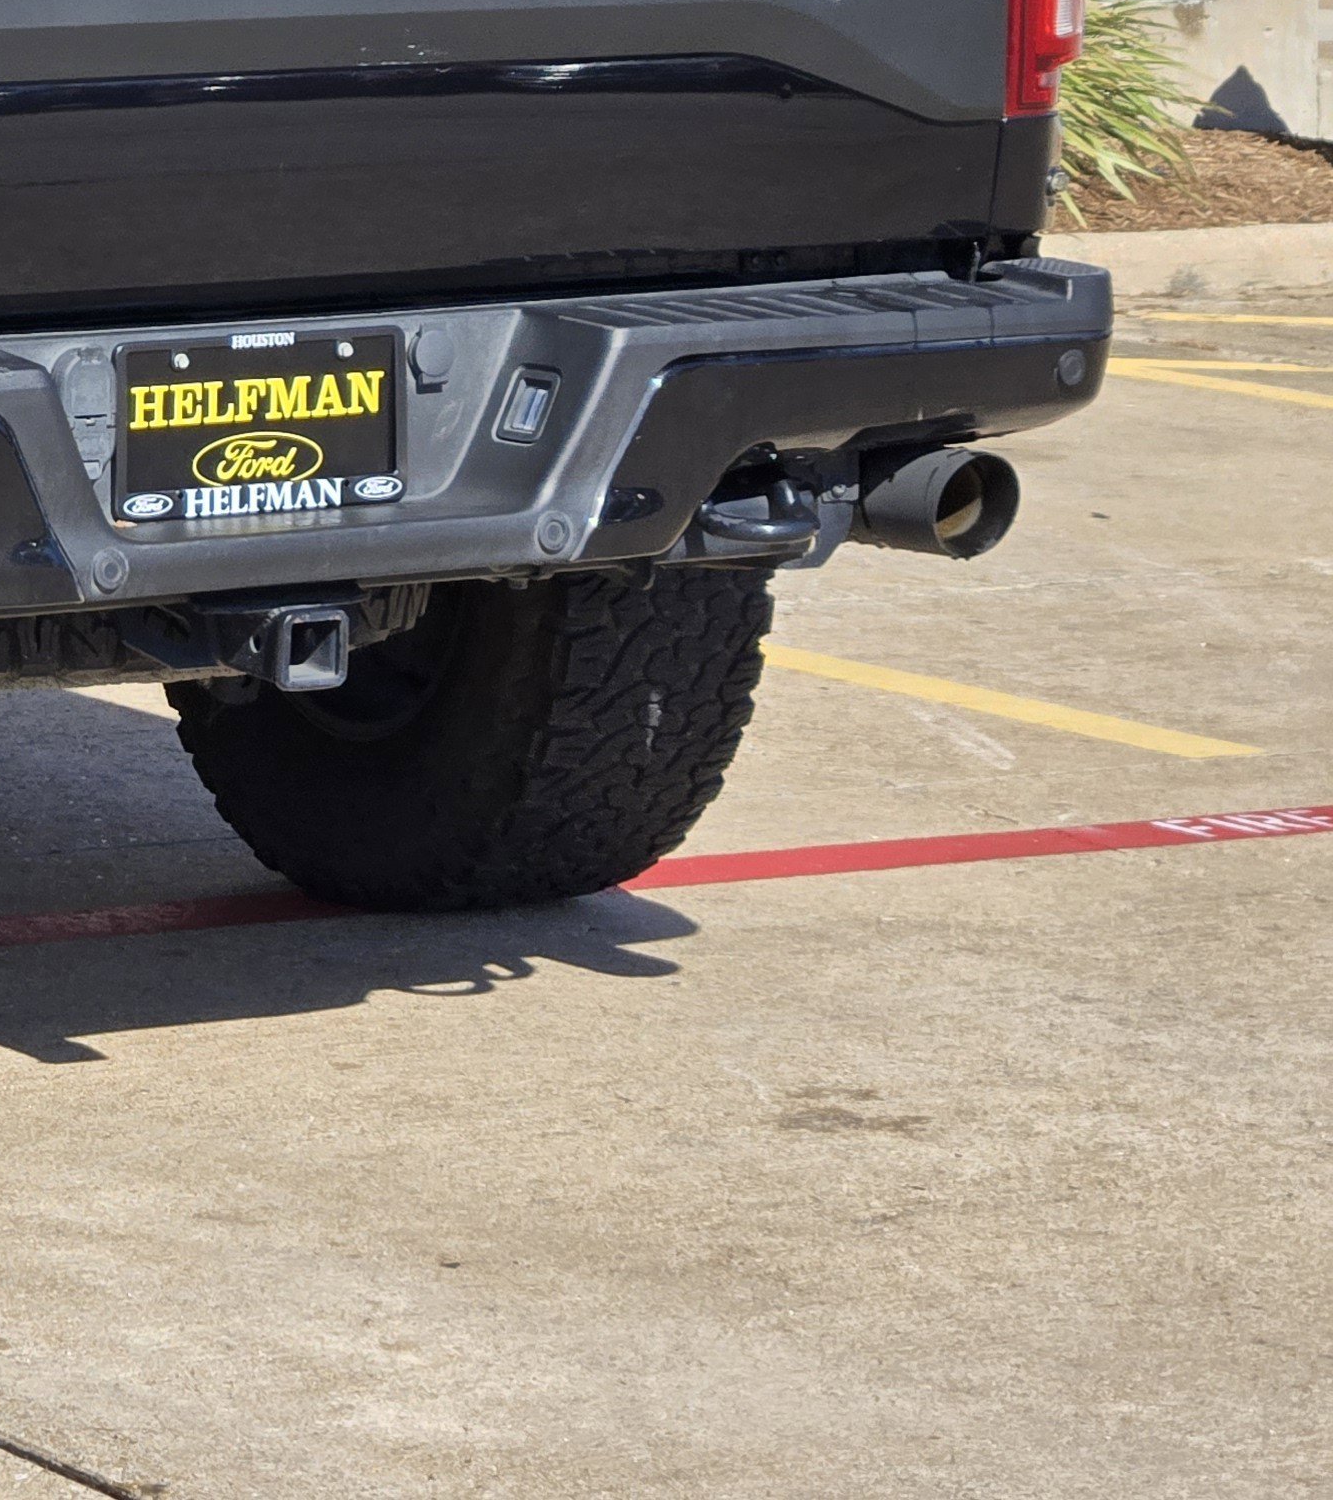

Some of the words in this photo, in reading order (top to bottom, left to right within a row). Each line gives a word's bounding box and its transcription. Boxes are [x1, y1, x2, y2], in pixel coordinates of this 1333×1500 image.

[231, 331, 296, 350] HOUSTON
[129, 370, 386, 431] HELFMAN
[215, 438, 298, 482] Ford
[131, 496, 165, 514] Ford
[183, 477, 346, 519] HELFMAN
[361, 476, 397, 496] Ford
